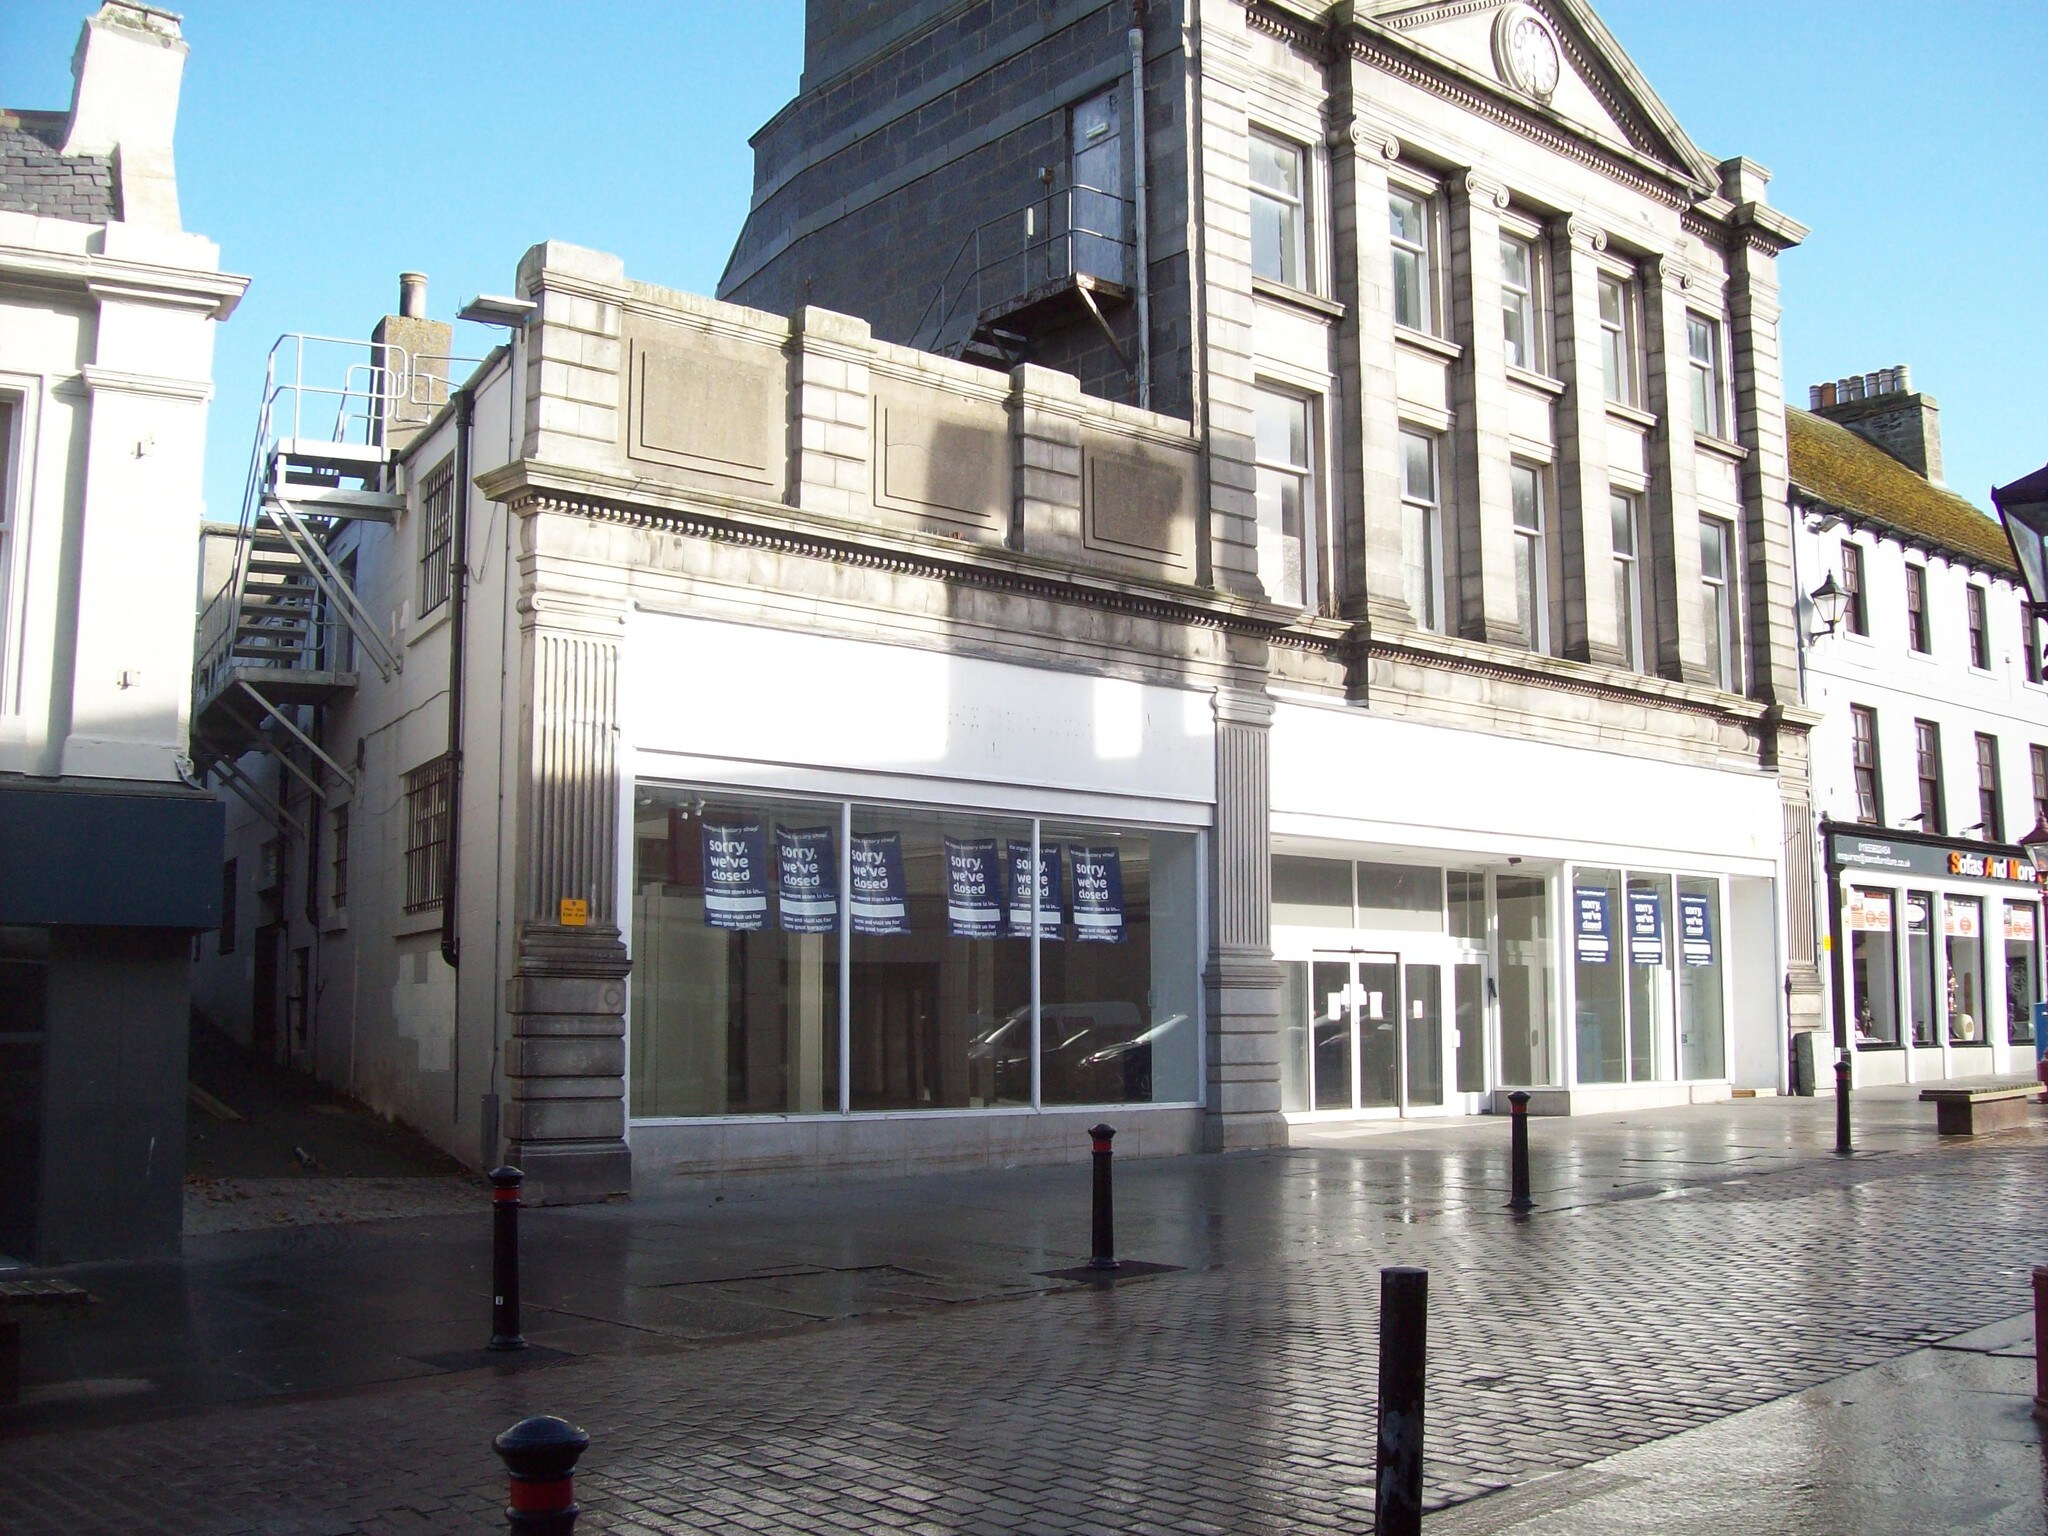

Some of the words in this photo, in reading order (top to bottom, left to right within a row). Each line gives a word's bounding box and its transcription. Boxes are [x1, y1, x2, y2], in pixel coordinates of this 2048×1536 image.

[709, 840, 748, 855] sorry,
[781, 845, 817, 861] sorry,
[710, 856, 749, 868] we've
[851, 849, 886, 865] sorry,
[782, 861, 818, 873] we've
[951, 856, 983, 871] sorry,
[1949, 850, 1984, 876] Sofas
[1985, 855, 2008, 879] And
[2009, 859, 2036, 882] More
[711, 869, 750, 881] closed
[853, 865, 887, 877] we've
[1076, 863, 1106, 877] sorry,
[784, 874, 820, 886] closed
[952, 871, 984, 882] we've
[1078, 877, 1107, 888] we've
[854, 878, 888, 889] closed
[953, 884, 986, 894] closed
[1079, 889, 1108, 900] closed
[1582, 911, 1601, 920] we've
